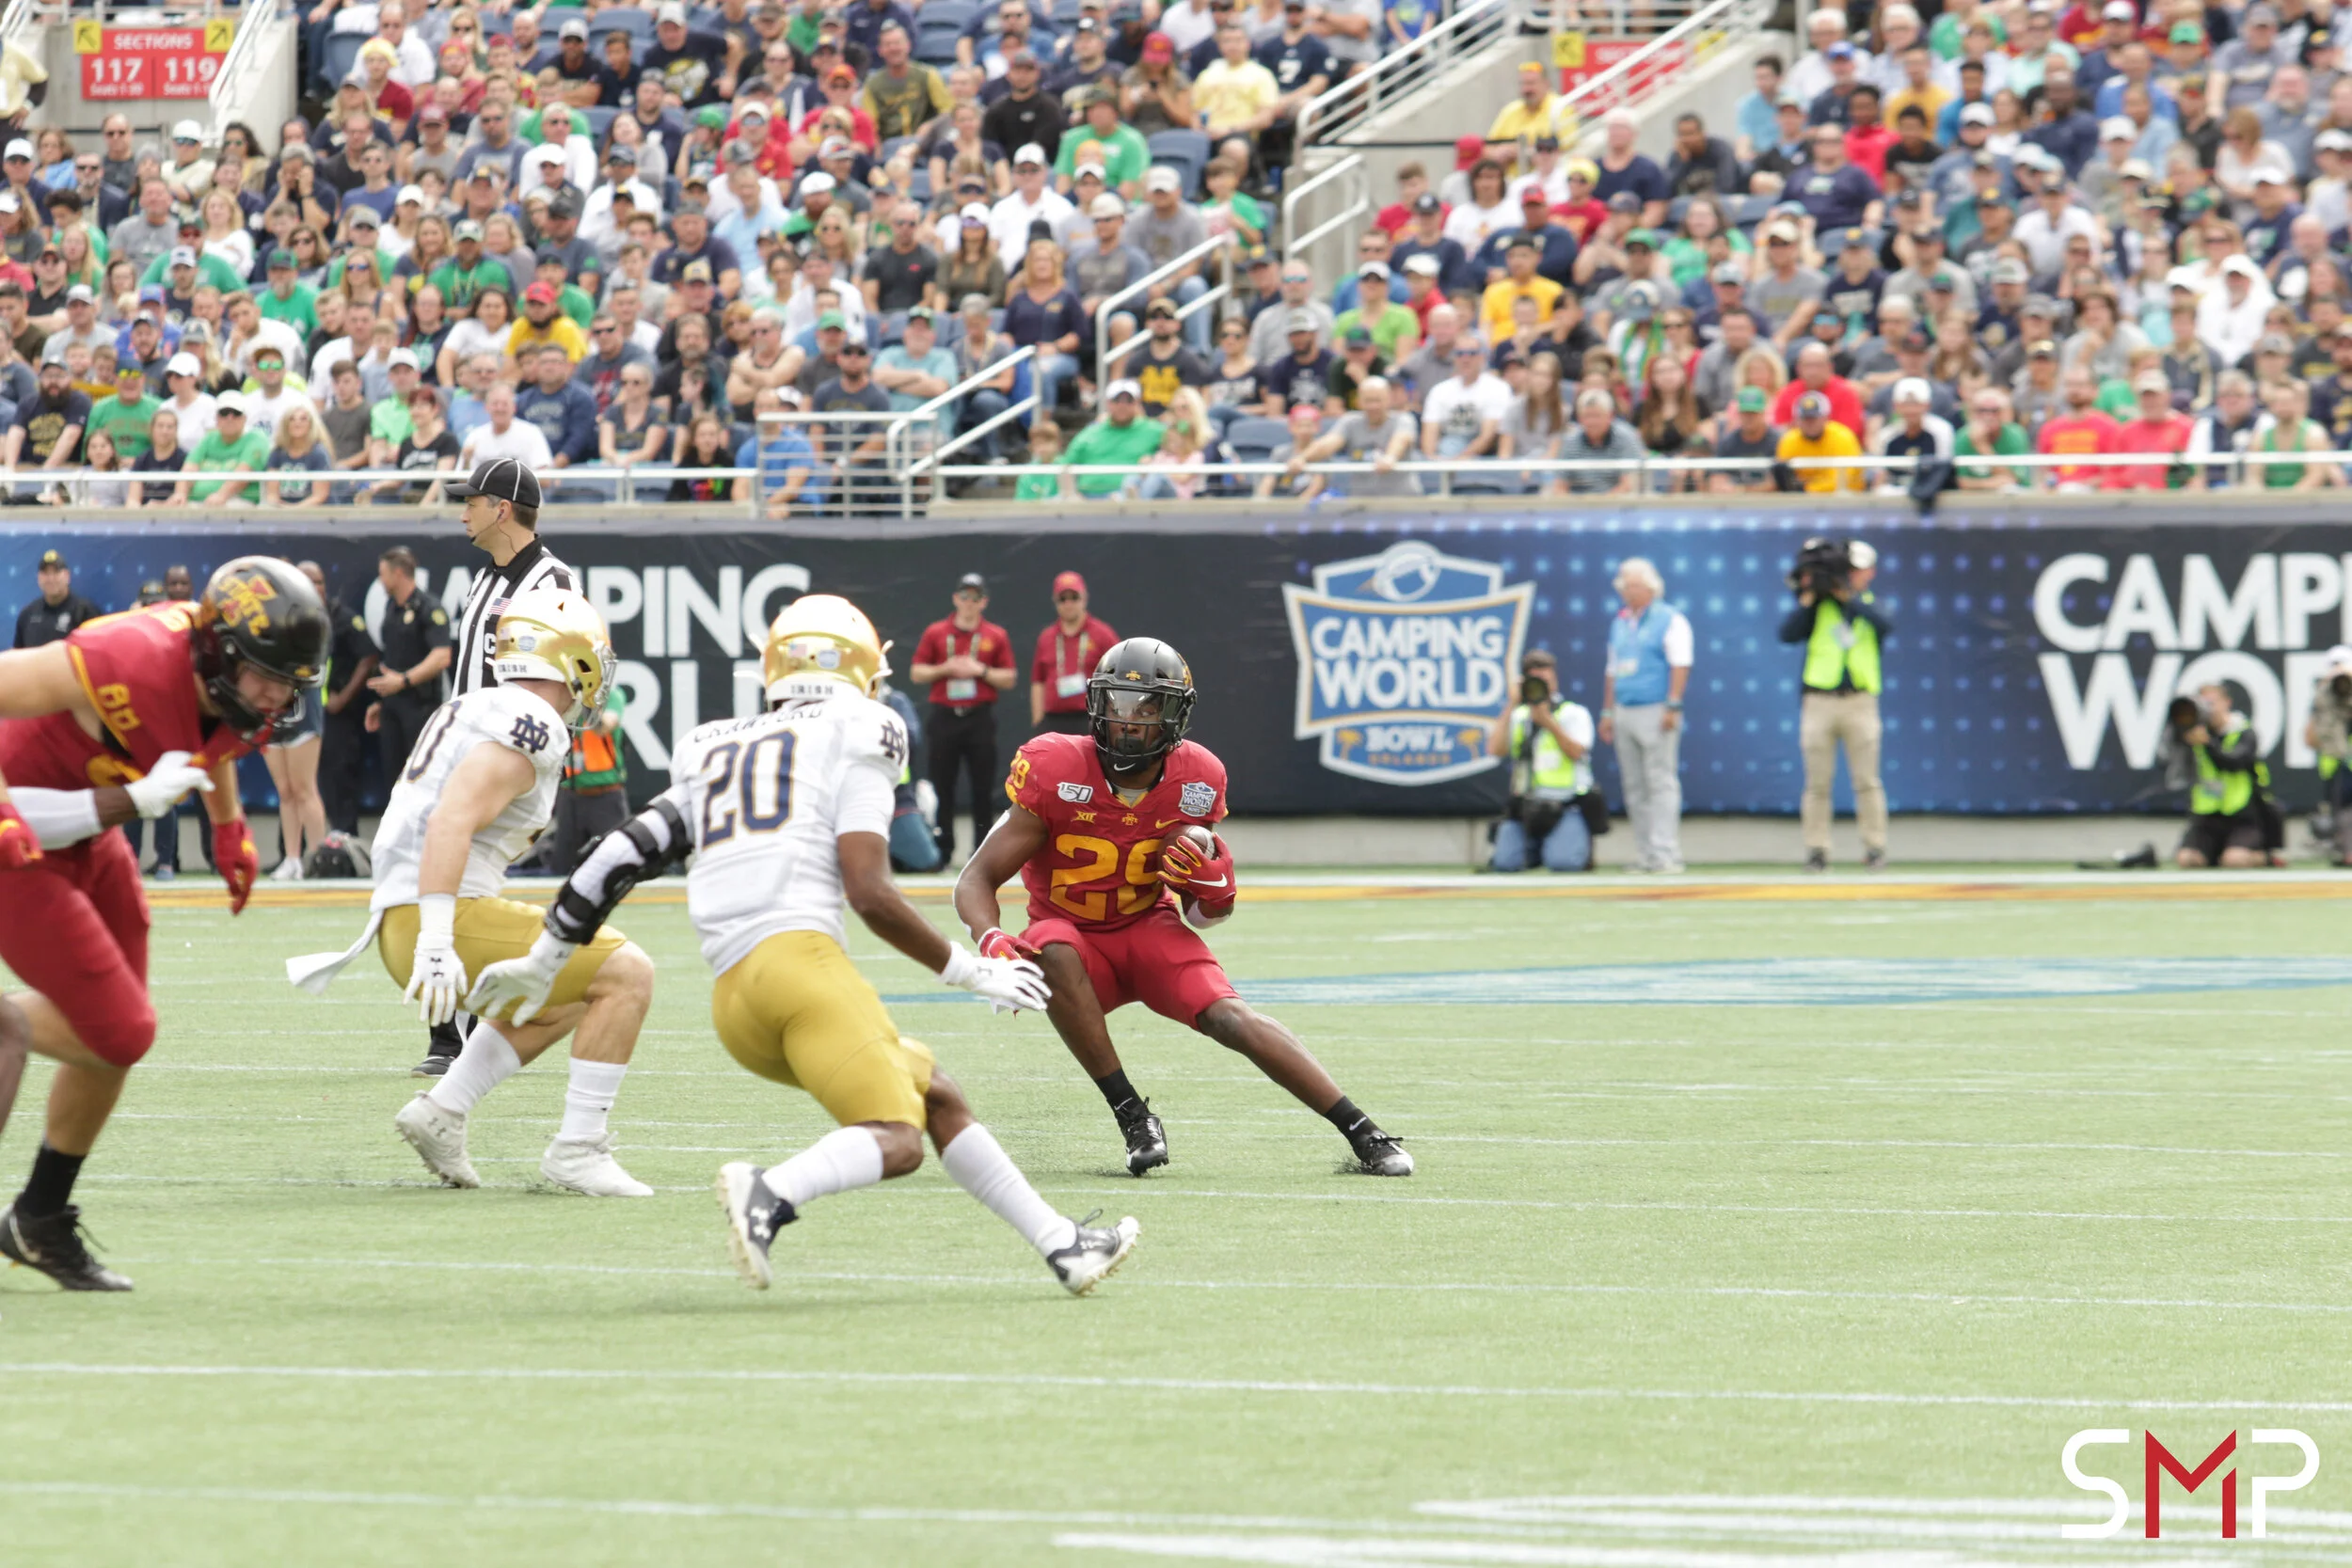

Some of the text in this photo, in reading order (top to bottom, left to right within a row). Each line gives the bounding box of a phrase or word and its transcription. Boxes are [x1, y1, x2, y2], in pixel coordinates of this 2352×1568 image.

[113, 32, 194, 50] SECTIONS
[90, 56, 143, 83] 117
[165, 56, 218, 83] 119
[1311, 616, 1505, 658] CAMPING
[790, 684, 834, 695] IRISH
[1313, 660, 1506, 708] WORLD
[1365, 725, 1454, 752] BOWL
[702, 726, 799, 851] 20
[1183, 796, 1211, 808] WORLD
[1184, 790, 1213, 801] CAMPING
